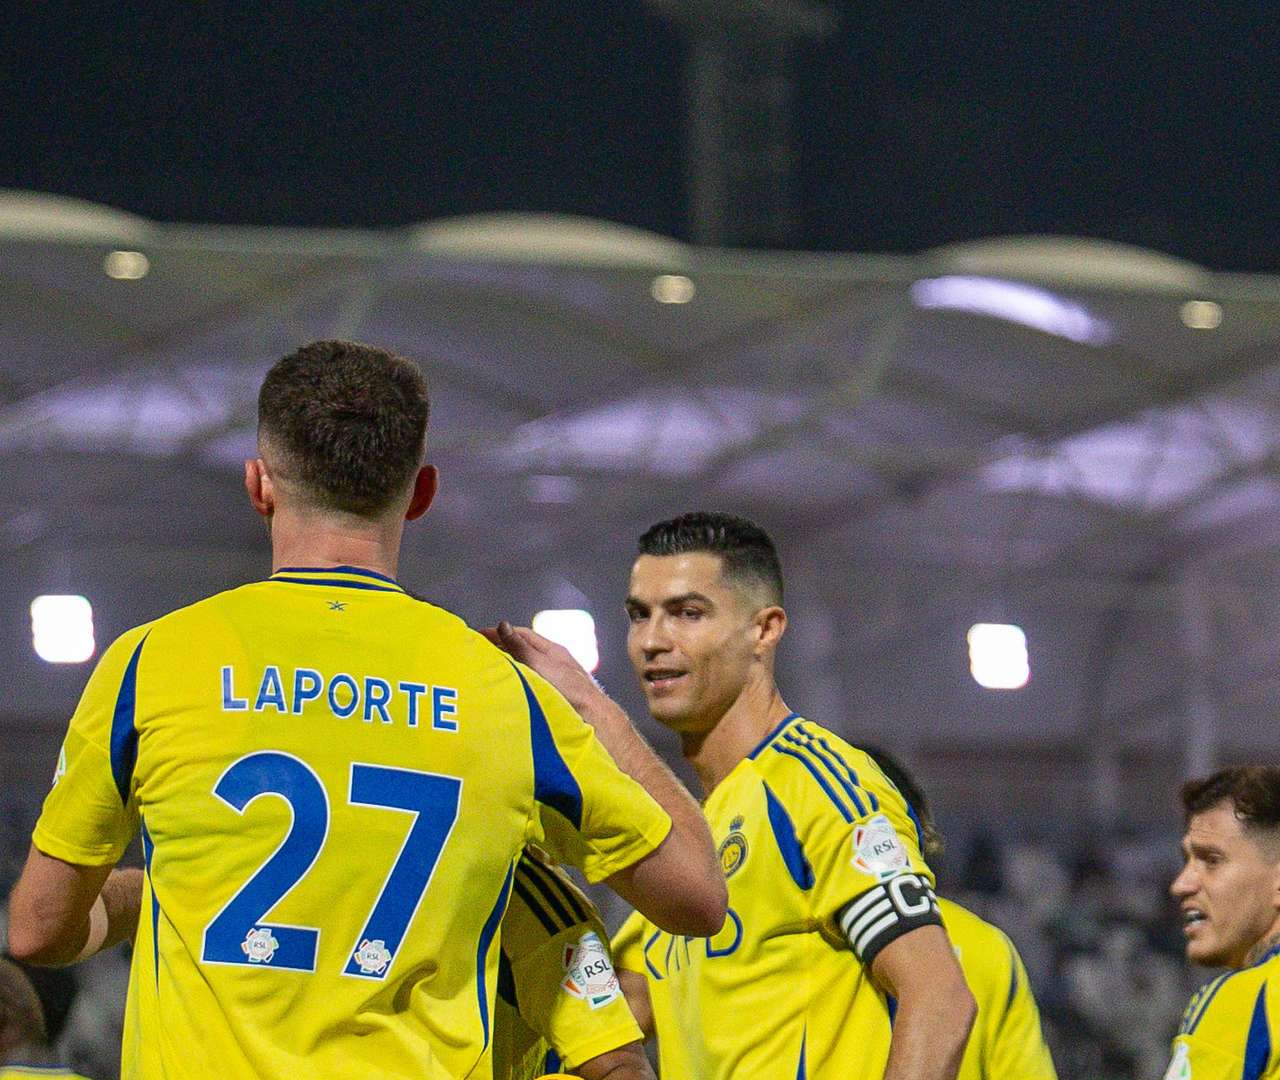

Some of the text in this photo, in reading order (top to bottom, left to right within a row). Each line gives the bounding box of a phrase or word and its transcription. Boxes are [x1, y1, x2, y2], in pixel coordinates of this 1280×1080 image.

[220, 664, 460, 733] LAPORTE
[200, 748, 464, 981] 27
[873, 839, 896, 856] RSL
[888, 874, 930, 917] C
[583, 959, 611, 978] RSL
